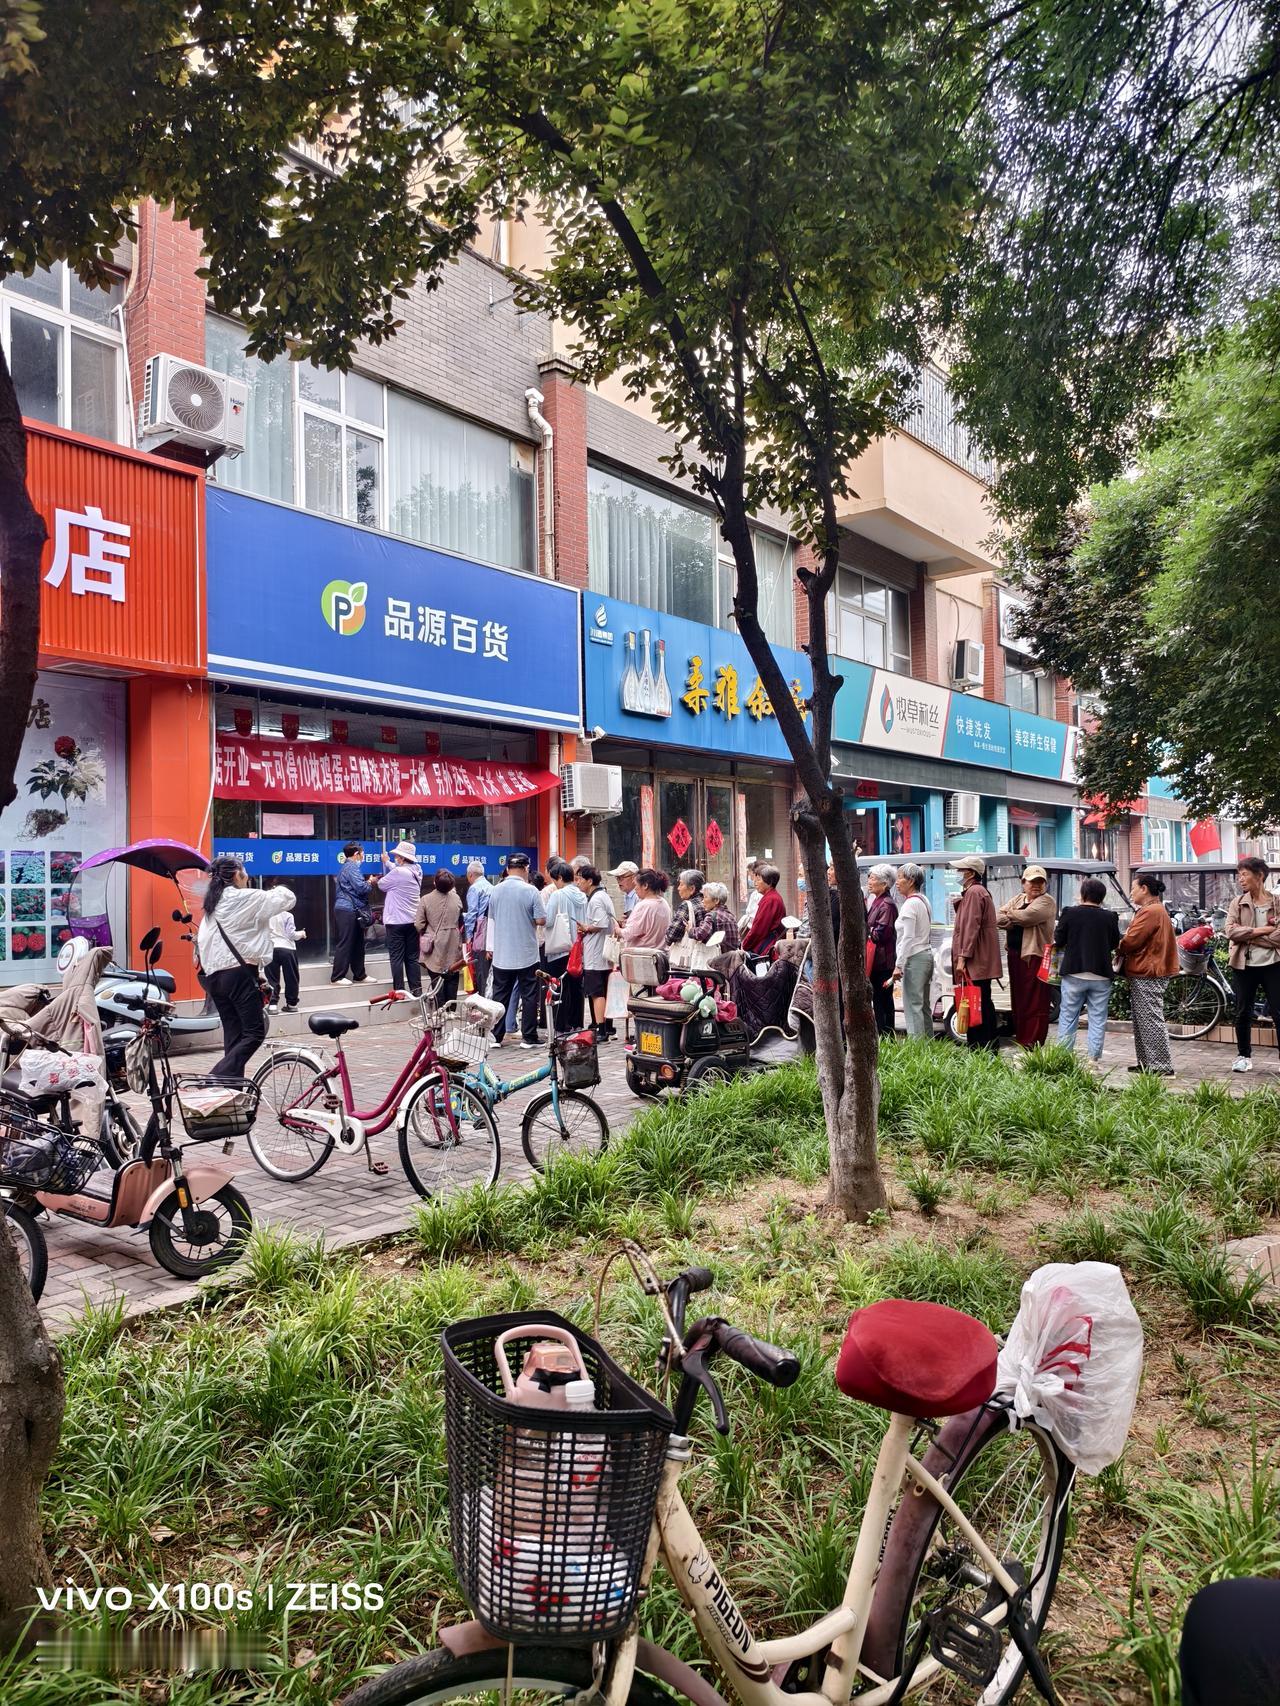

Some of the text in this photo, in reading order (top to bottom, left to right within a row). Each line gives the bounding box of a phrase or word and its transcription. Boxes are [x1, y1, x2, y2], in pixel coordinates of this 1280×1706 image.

[44, 505, 132, 603] 店
[383, 596, 510, 663] 品源百货
[955, 715, 992, 741] 快捷洗发
[1014, 728, 1057, 754] 美容养生保健
[286, 852, 320, 864] 品源百货
[704, 1571, 752, 1653] PIGEON
